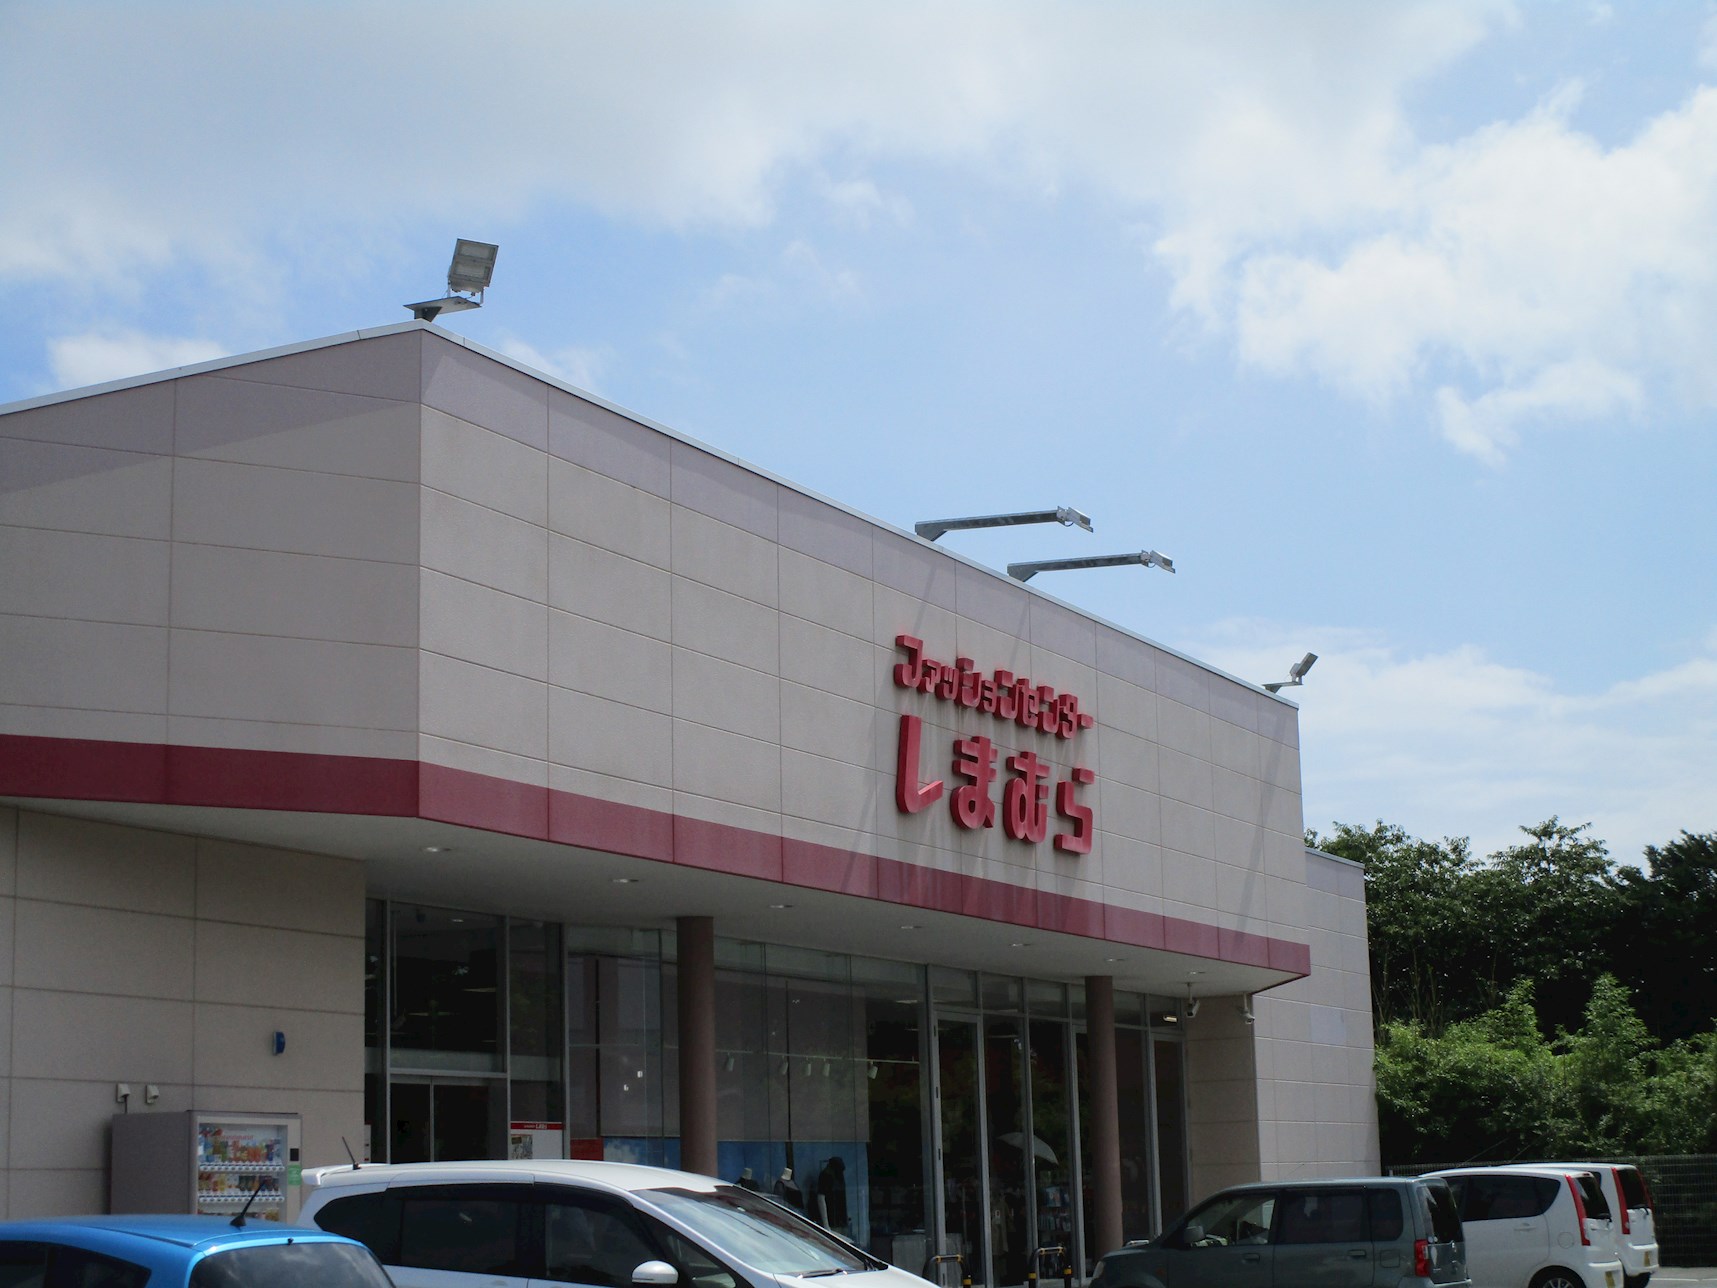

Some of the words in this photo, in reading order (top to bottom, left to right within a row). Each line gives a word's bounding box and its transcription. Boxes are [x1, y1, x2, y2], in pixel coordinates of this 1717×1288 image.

[895, 635, 1093, 738] ファッションセンター
[896, 715, 1094, 854] しまむら
